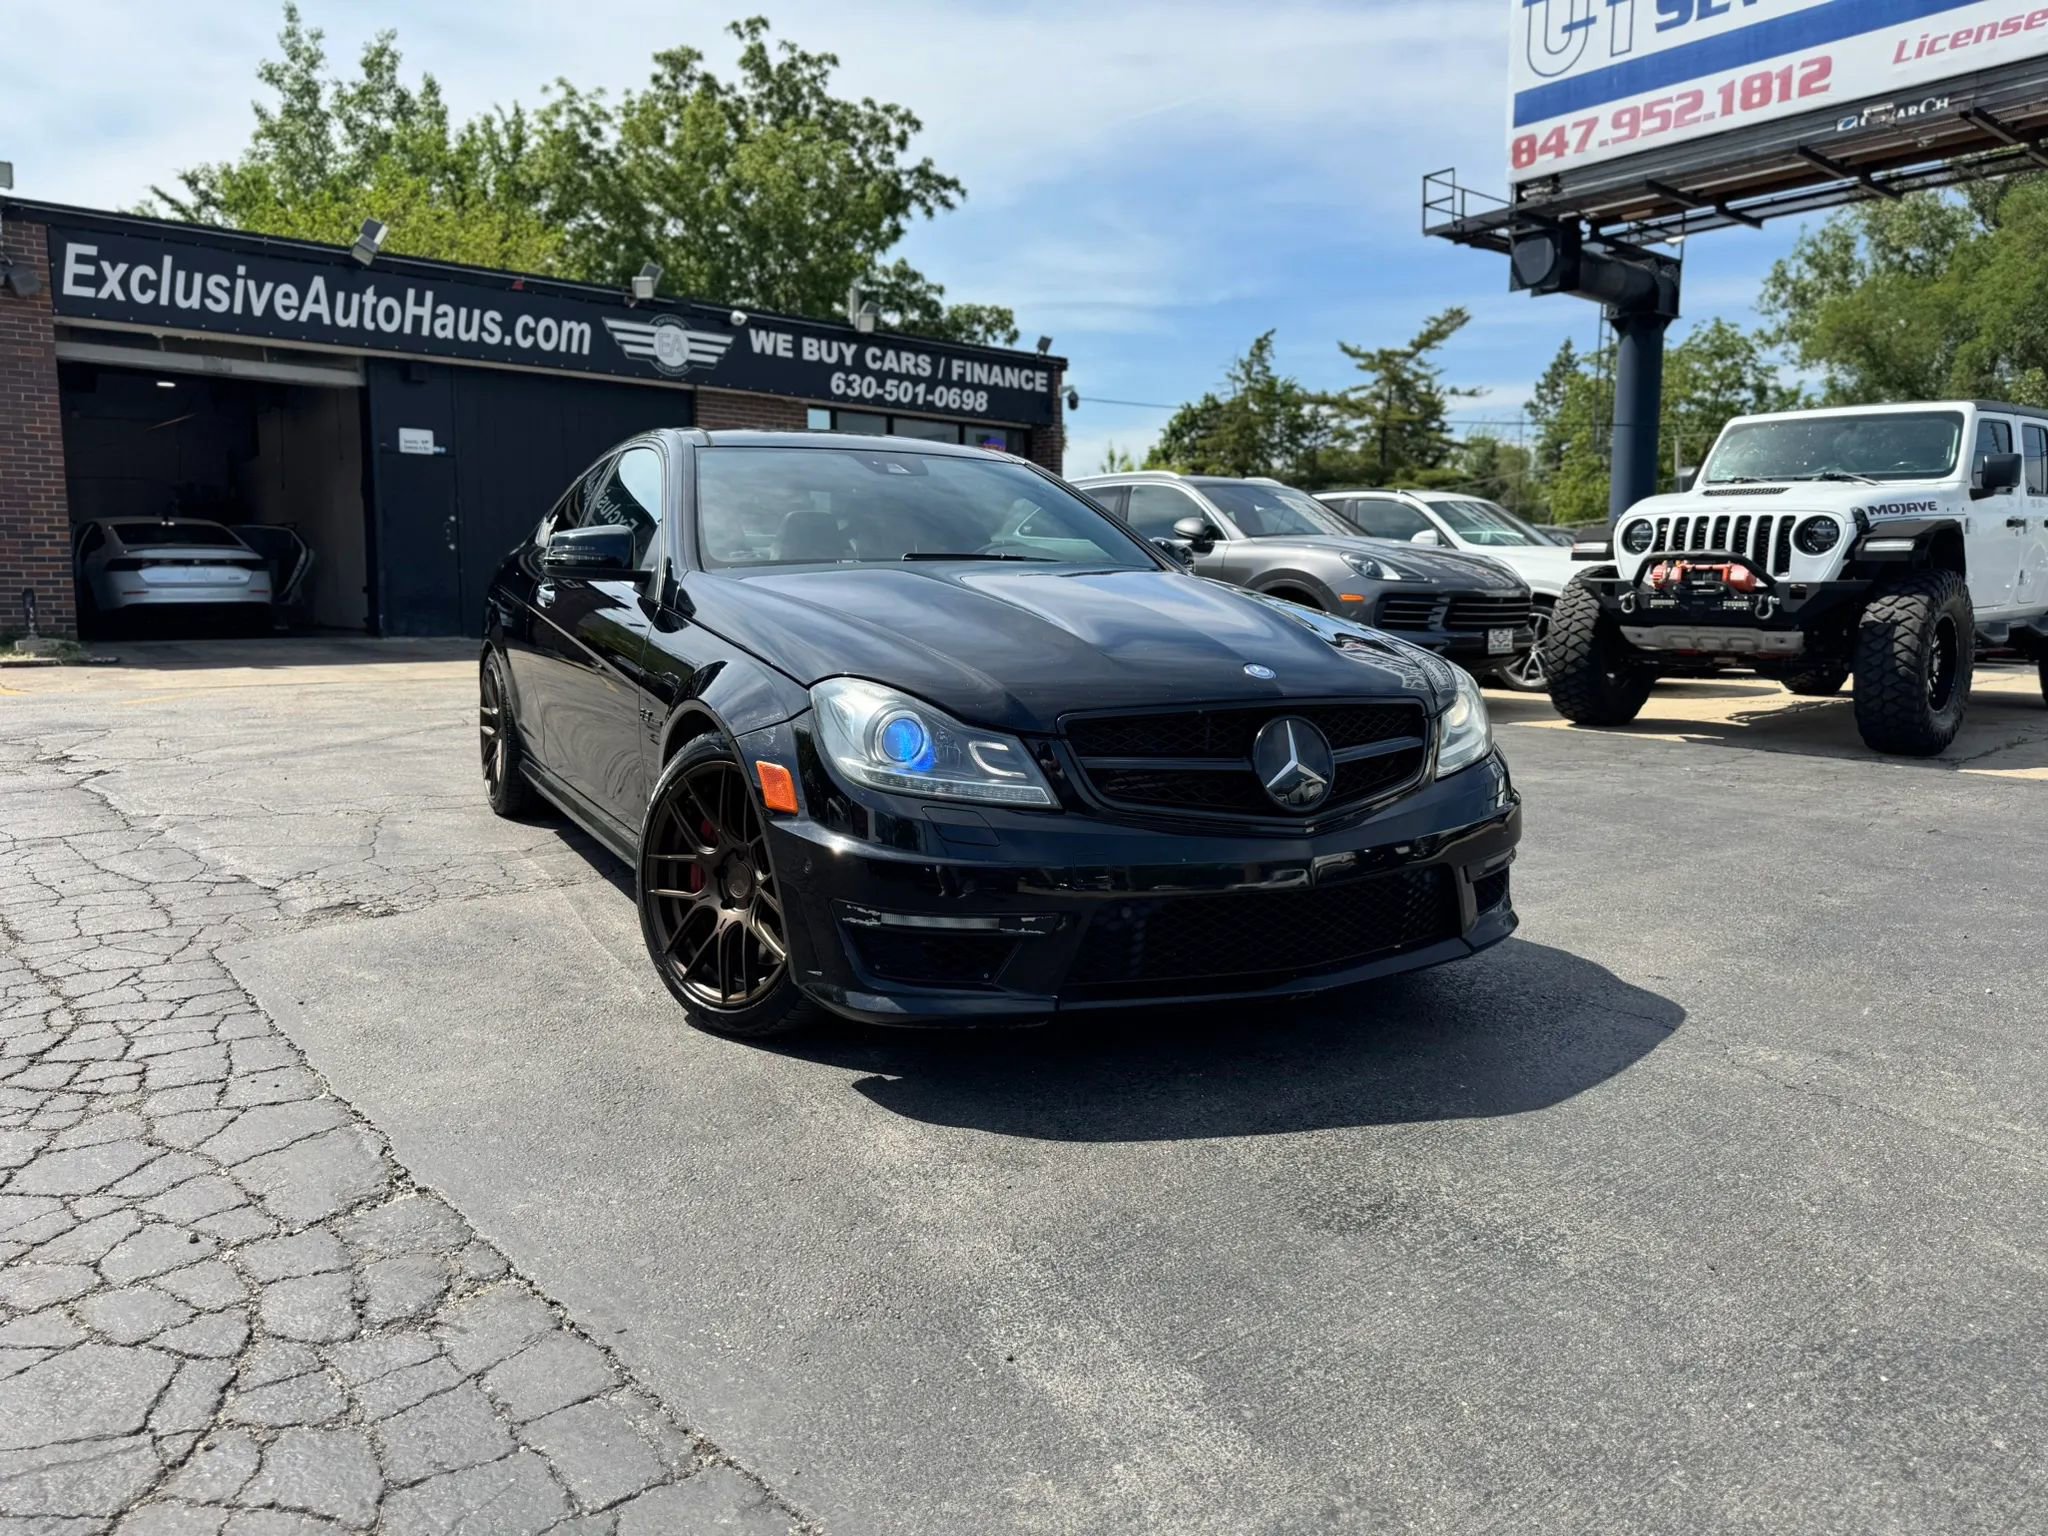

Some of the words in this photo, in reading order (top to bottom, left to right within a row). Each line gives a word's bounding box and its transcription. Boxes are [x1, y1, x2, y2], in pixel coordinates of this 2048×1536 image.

[1512, 55, 1833, 170] 847.952.1812
[62, 242, 592, 355] ExclusiveAutoHaus.com
[749, 328, 794, 358] WE
[802, 337, 858, 366] BUY
[865, 347, 932, 377] CARS
[938, 357, 946, 379] /
[951, 359, 1048, 392] FINANCE
[830, 372, 989, 413] 630-501-0698
[1867, 500, 1938, 516] MOJAVE
